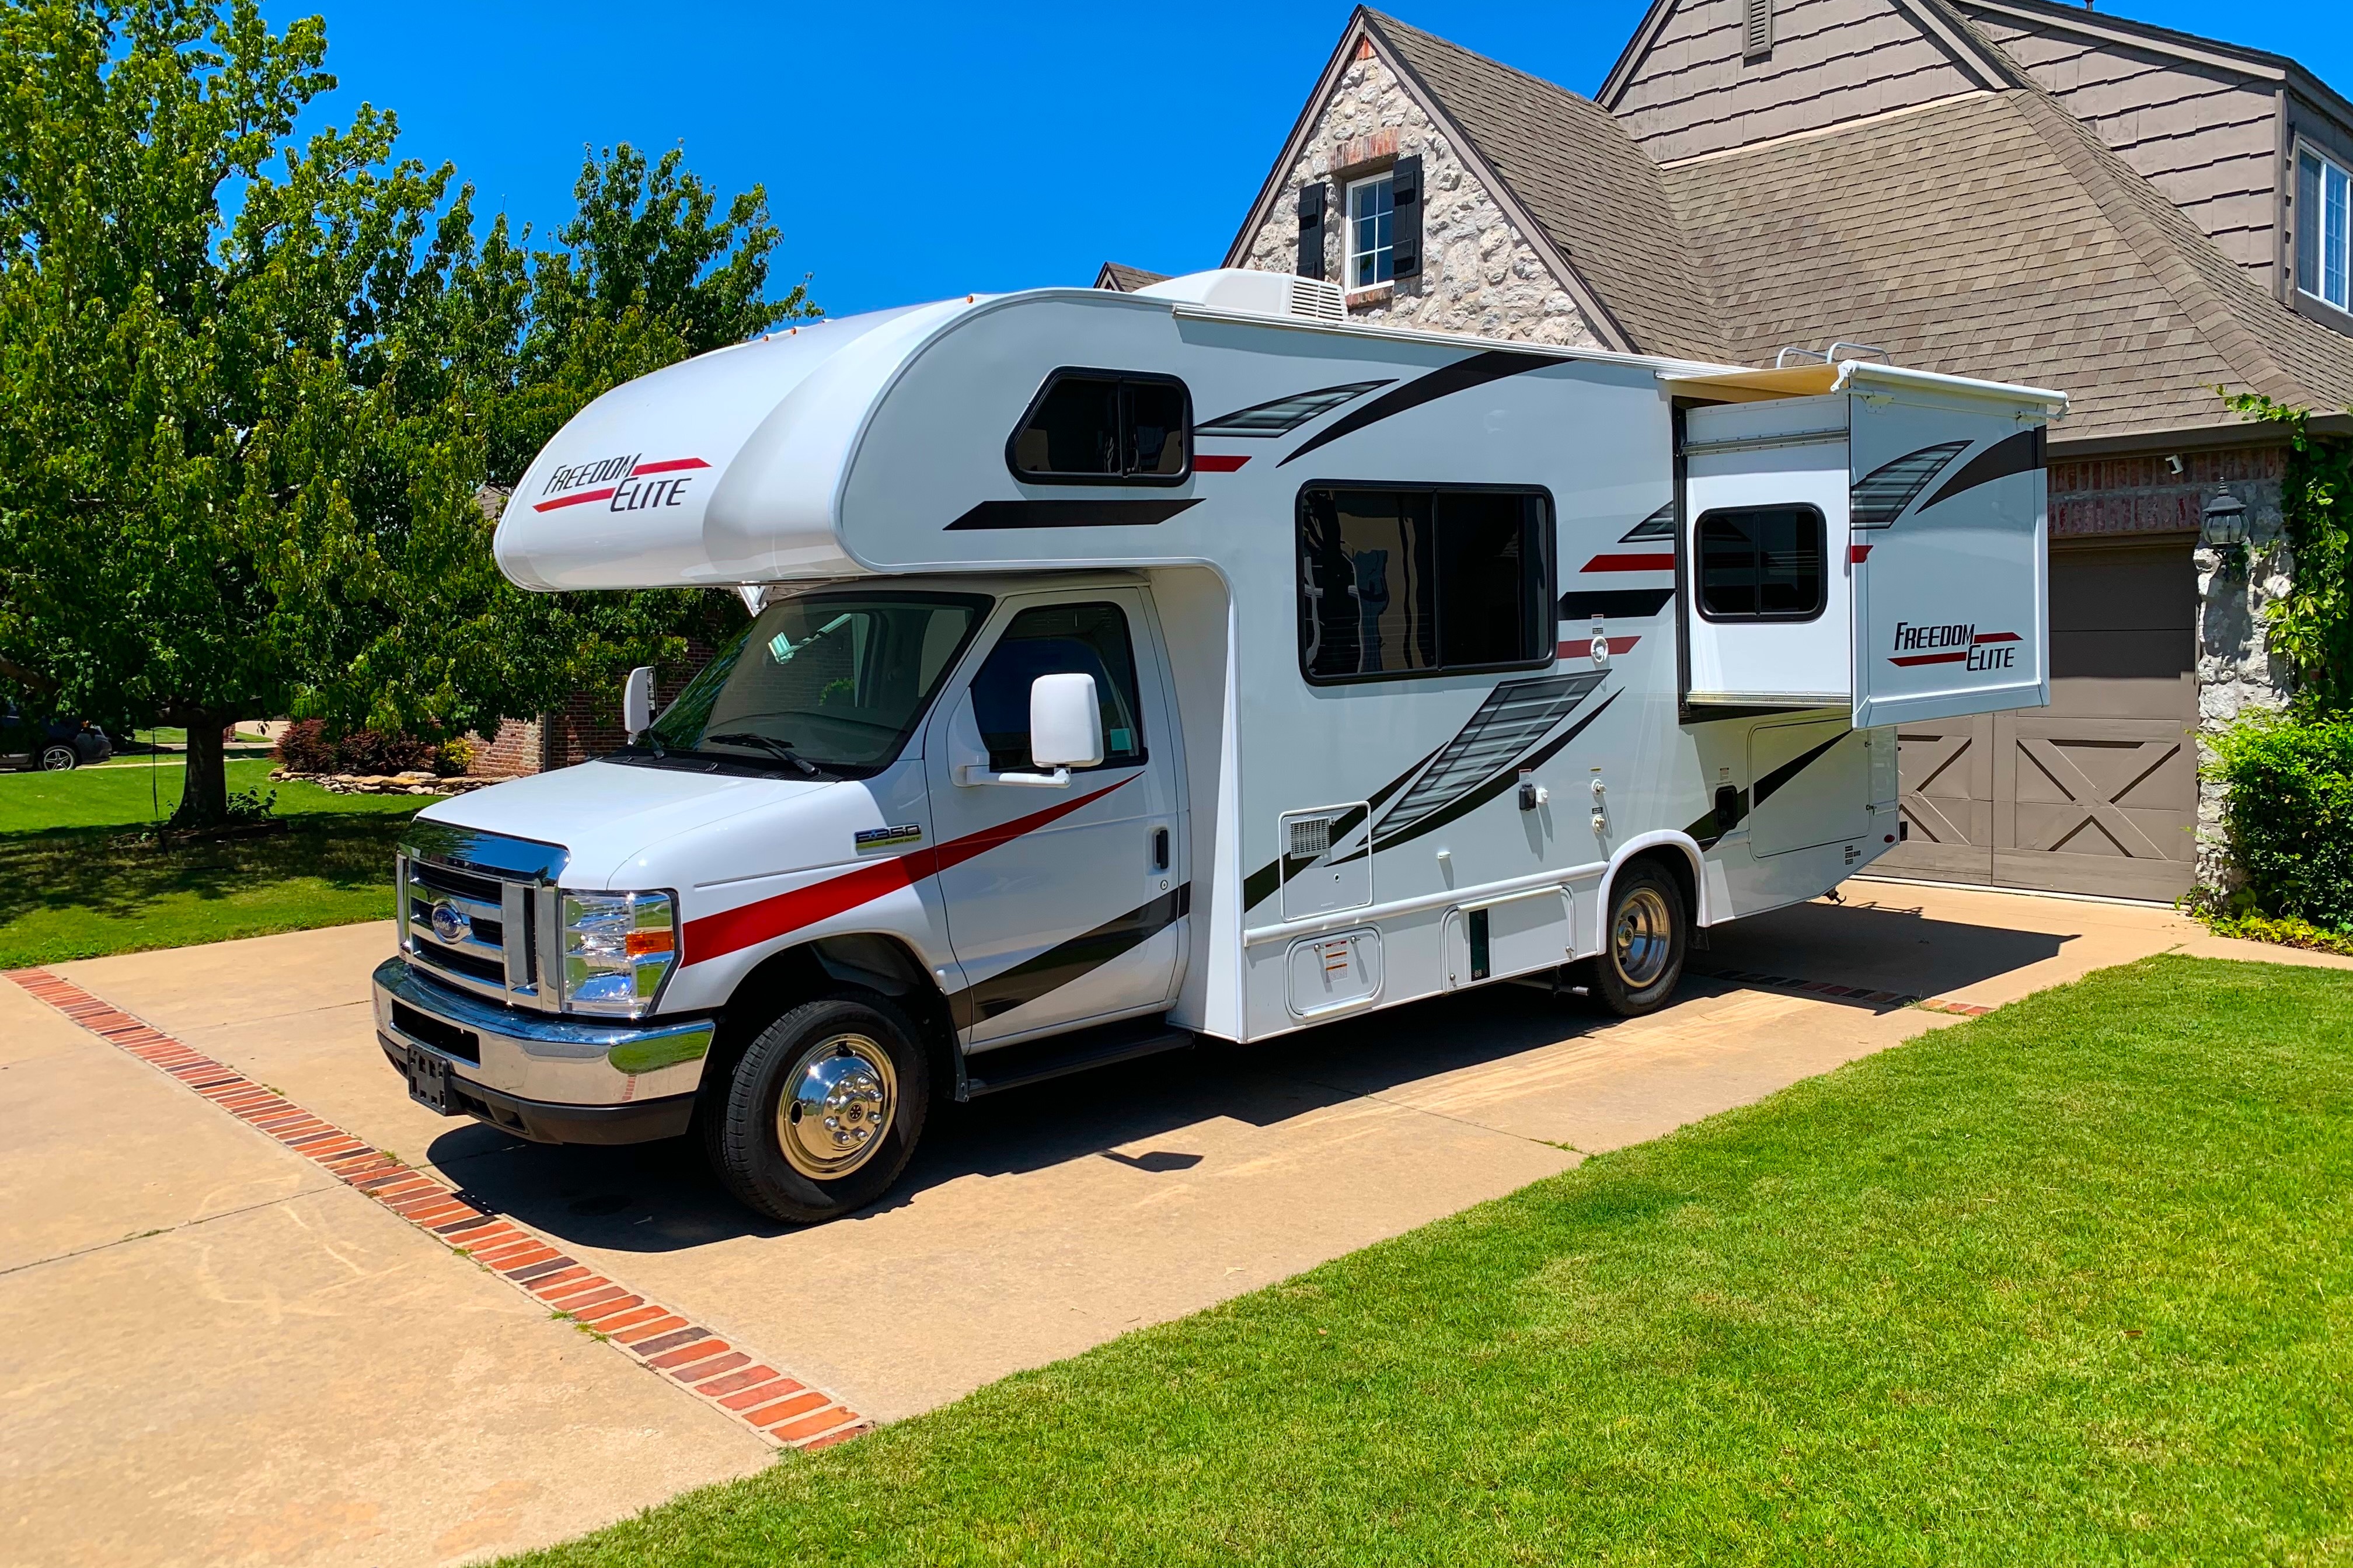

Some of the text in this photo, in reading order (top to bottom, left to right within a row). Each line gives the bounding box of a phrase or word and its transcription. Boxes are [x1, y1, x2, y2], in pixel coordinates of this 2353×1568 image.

[542, 453, 642, 496] FREEDOM
[610, 477, 693, 512] ELITE
[1894, 621, 1975, 651] FREEDOM
[1966, 644, 2016, 672] ELITE
